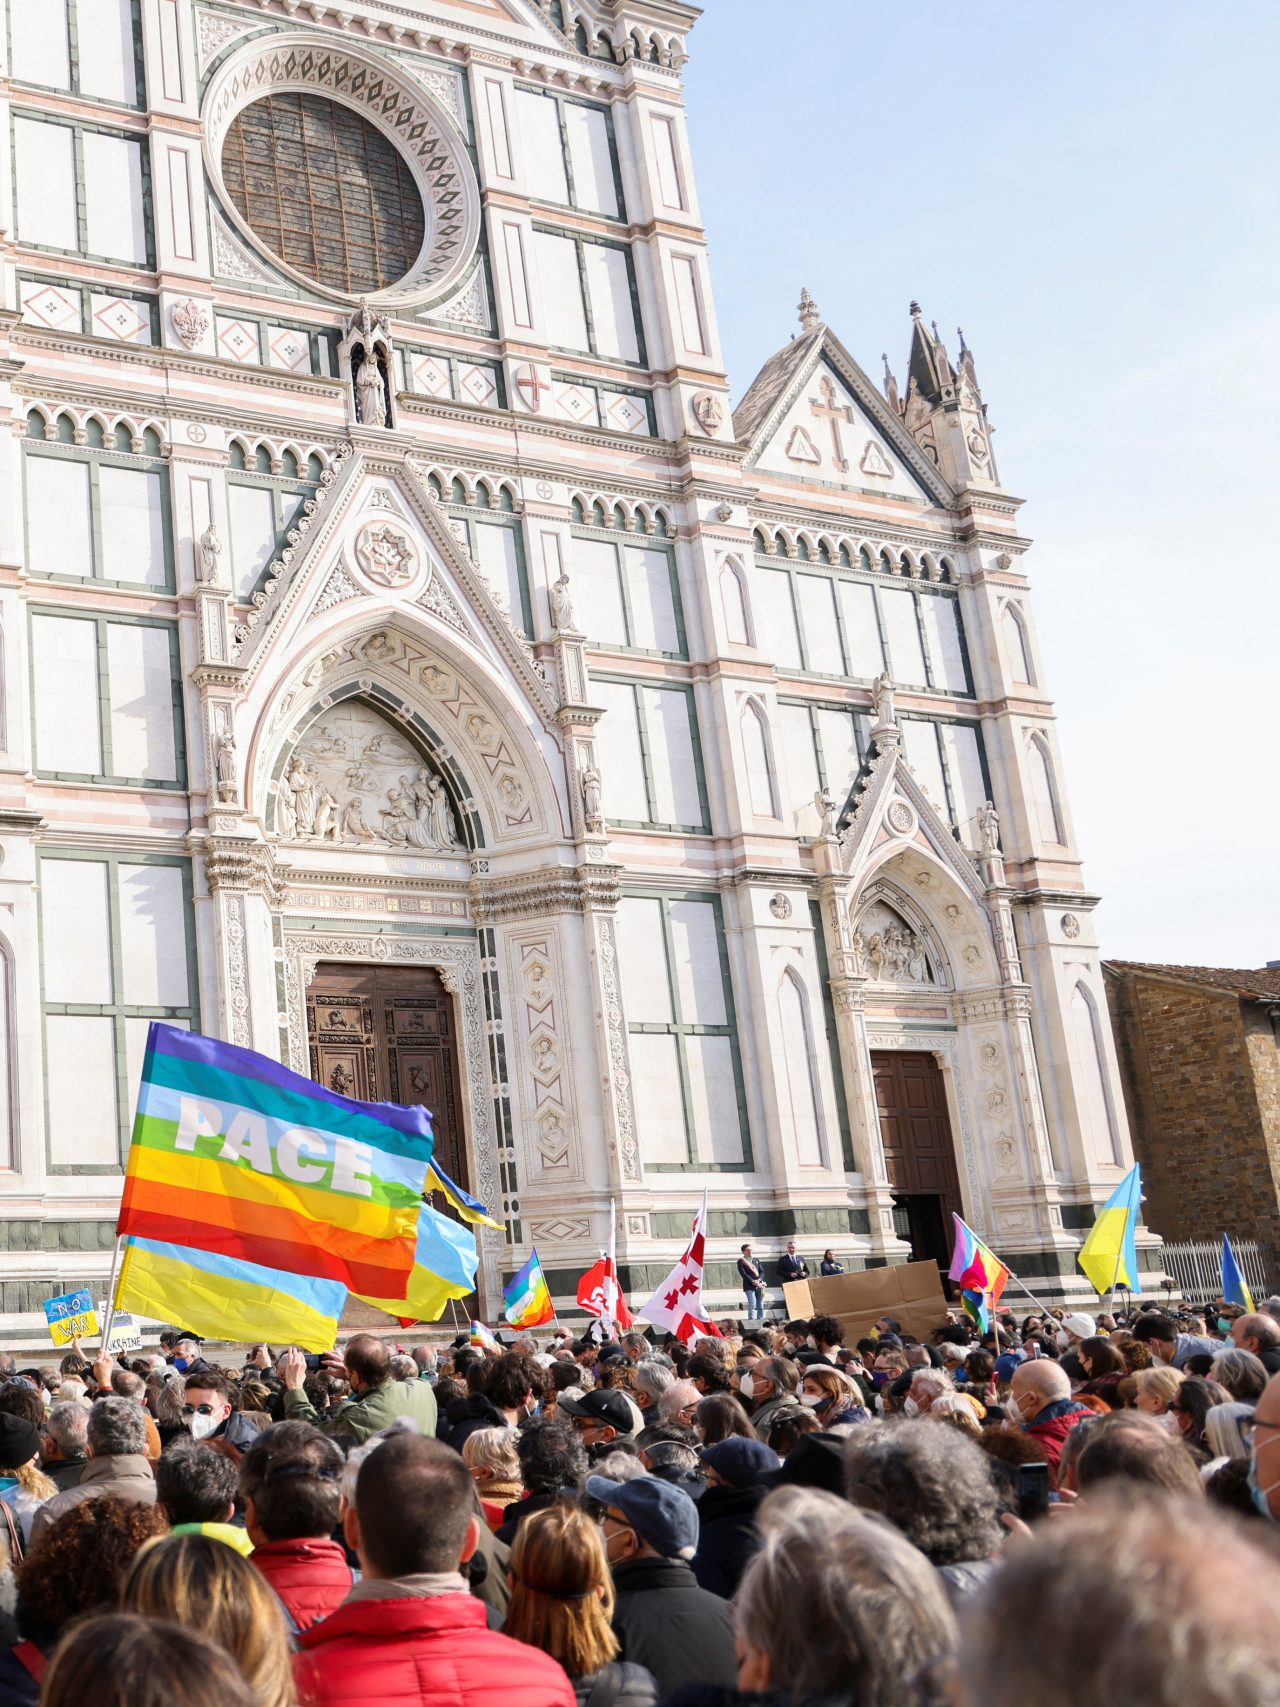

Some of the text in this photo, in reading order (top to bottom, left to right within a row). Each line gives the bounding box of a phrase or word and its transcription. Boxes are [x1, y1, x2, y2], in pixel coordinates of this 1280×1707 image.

[174, 1097, 373, 1197] PACE
[57, 1298, 81, 1316] NO
[58, 1316, 89, 1337] WAR
